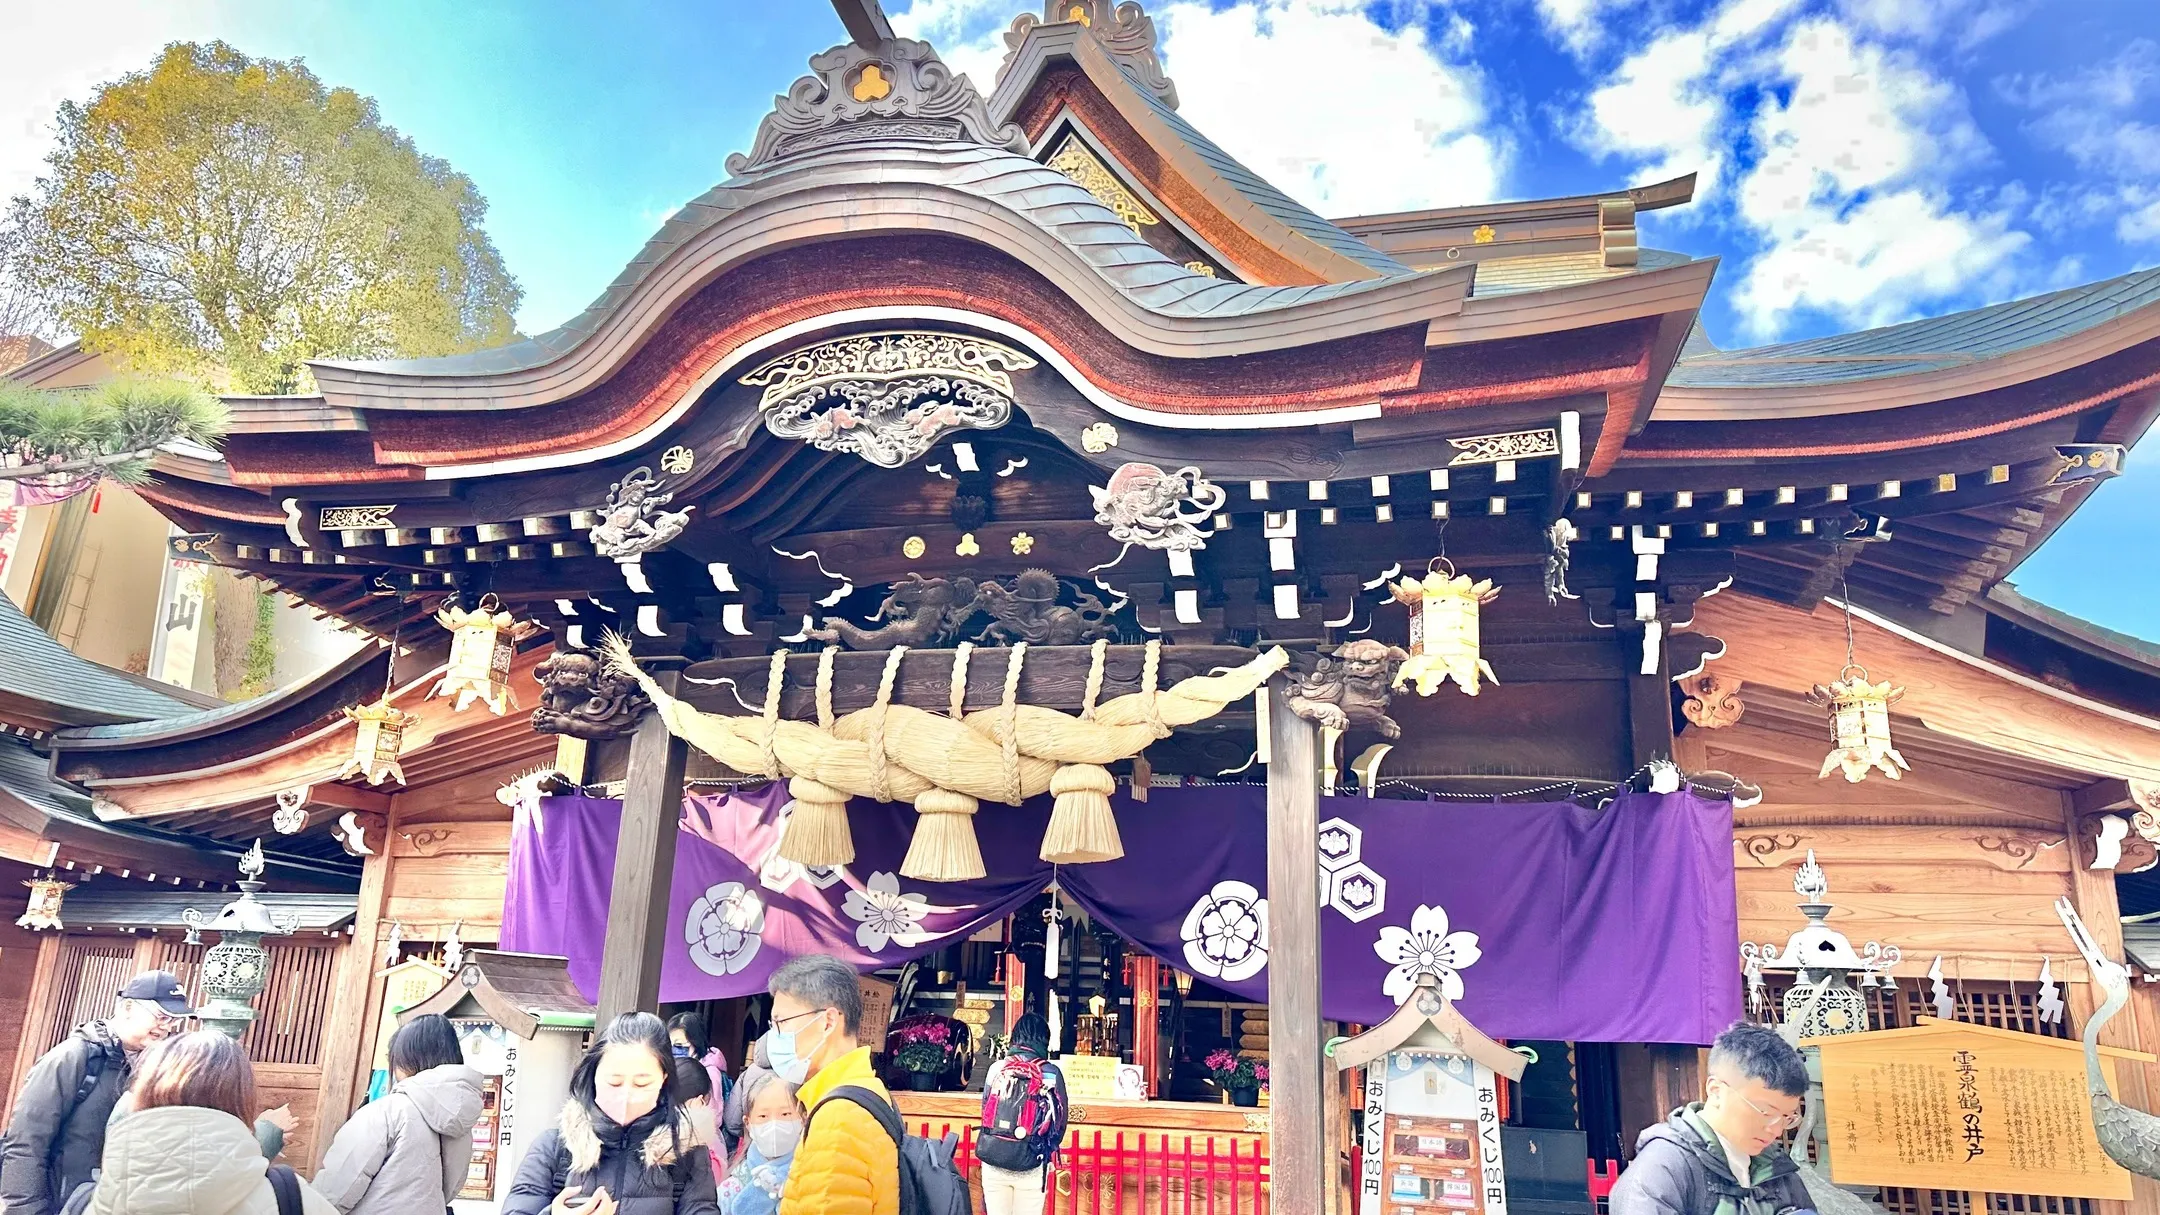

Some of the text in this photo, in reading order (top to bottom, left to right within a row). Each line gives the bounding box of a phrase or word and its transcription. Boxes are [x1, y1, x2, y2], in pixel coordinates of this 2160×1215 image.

[165, 593, 198, 632] 山
[1363, 1080, 1384, 1196] おみくじ100円
[1478, 1087, 1503, 1204] おみくじ100円
[1953, 1051, 1985, 1163] 霊泉鶴の井戸
